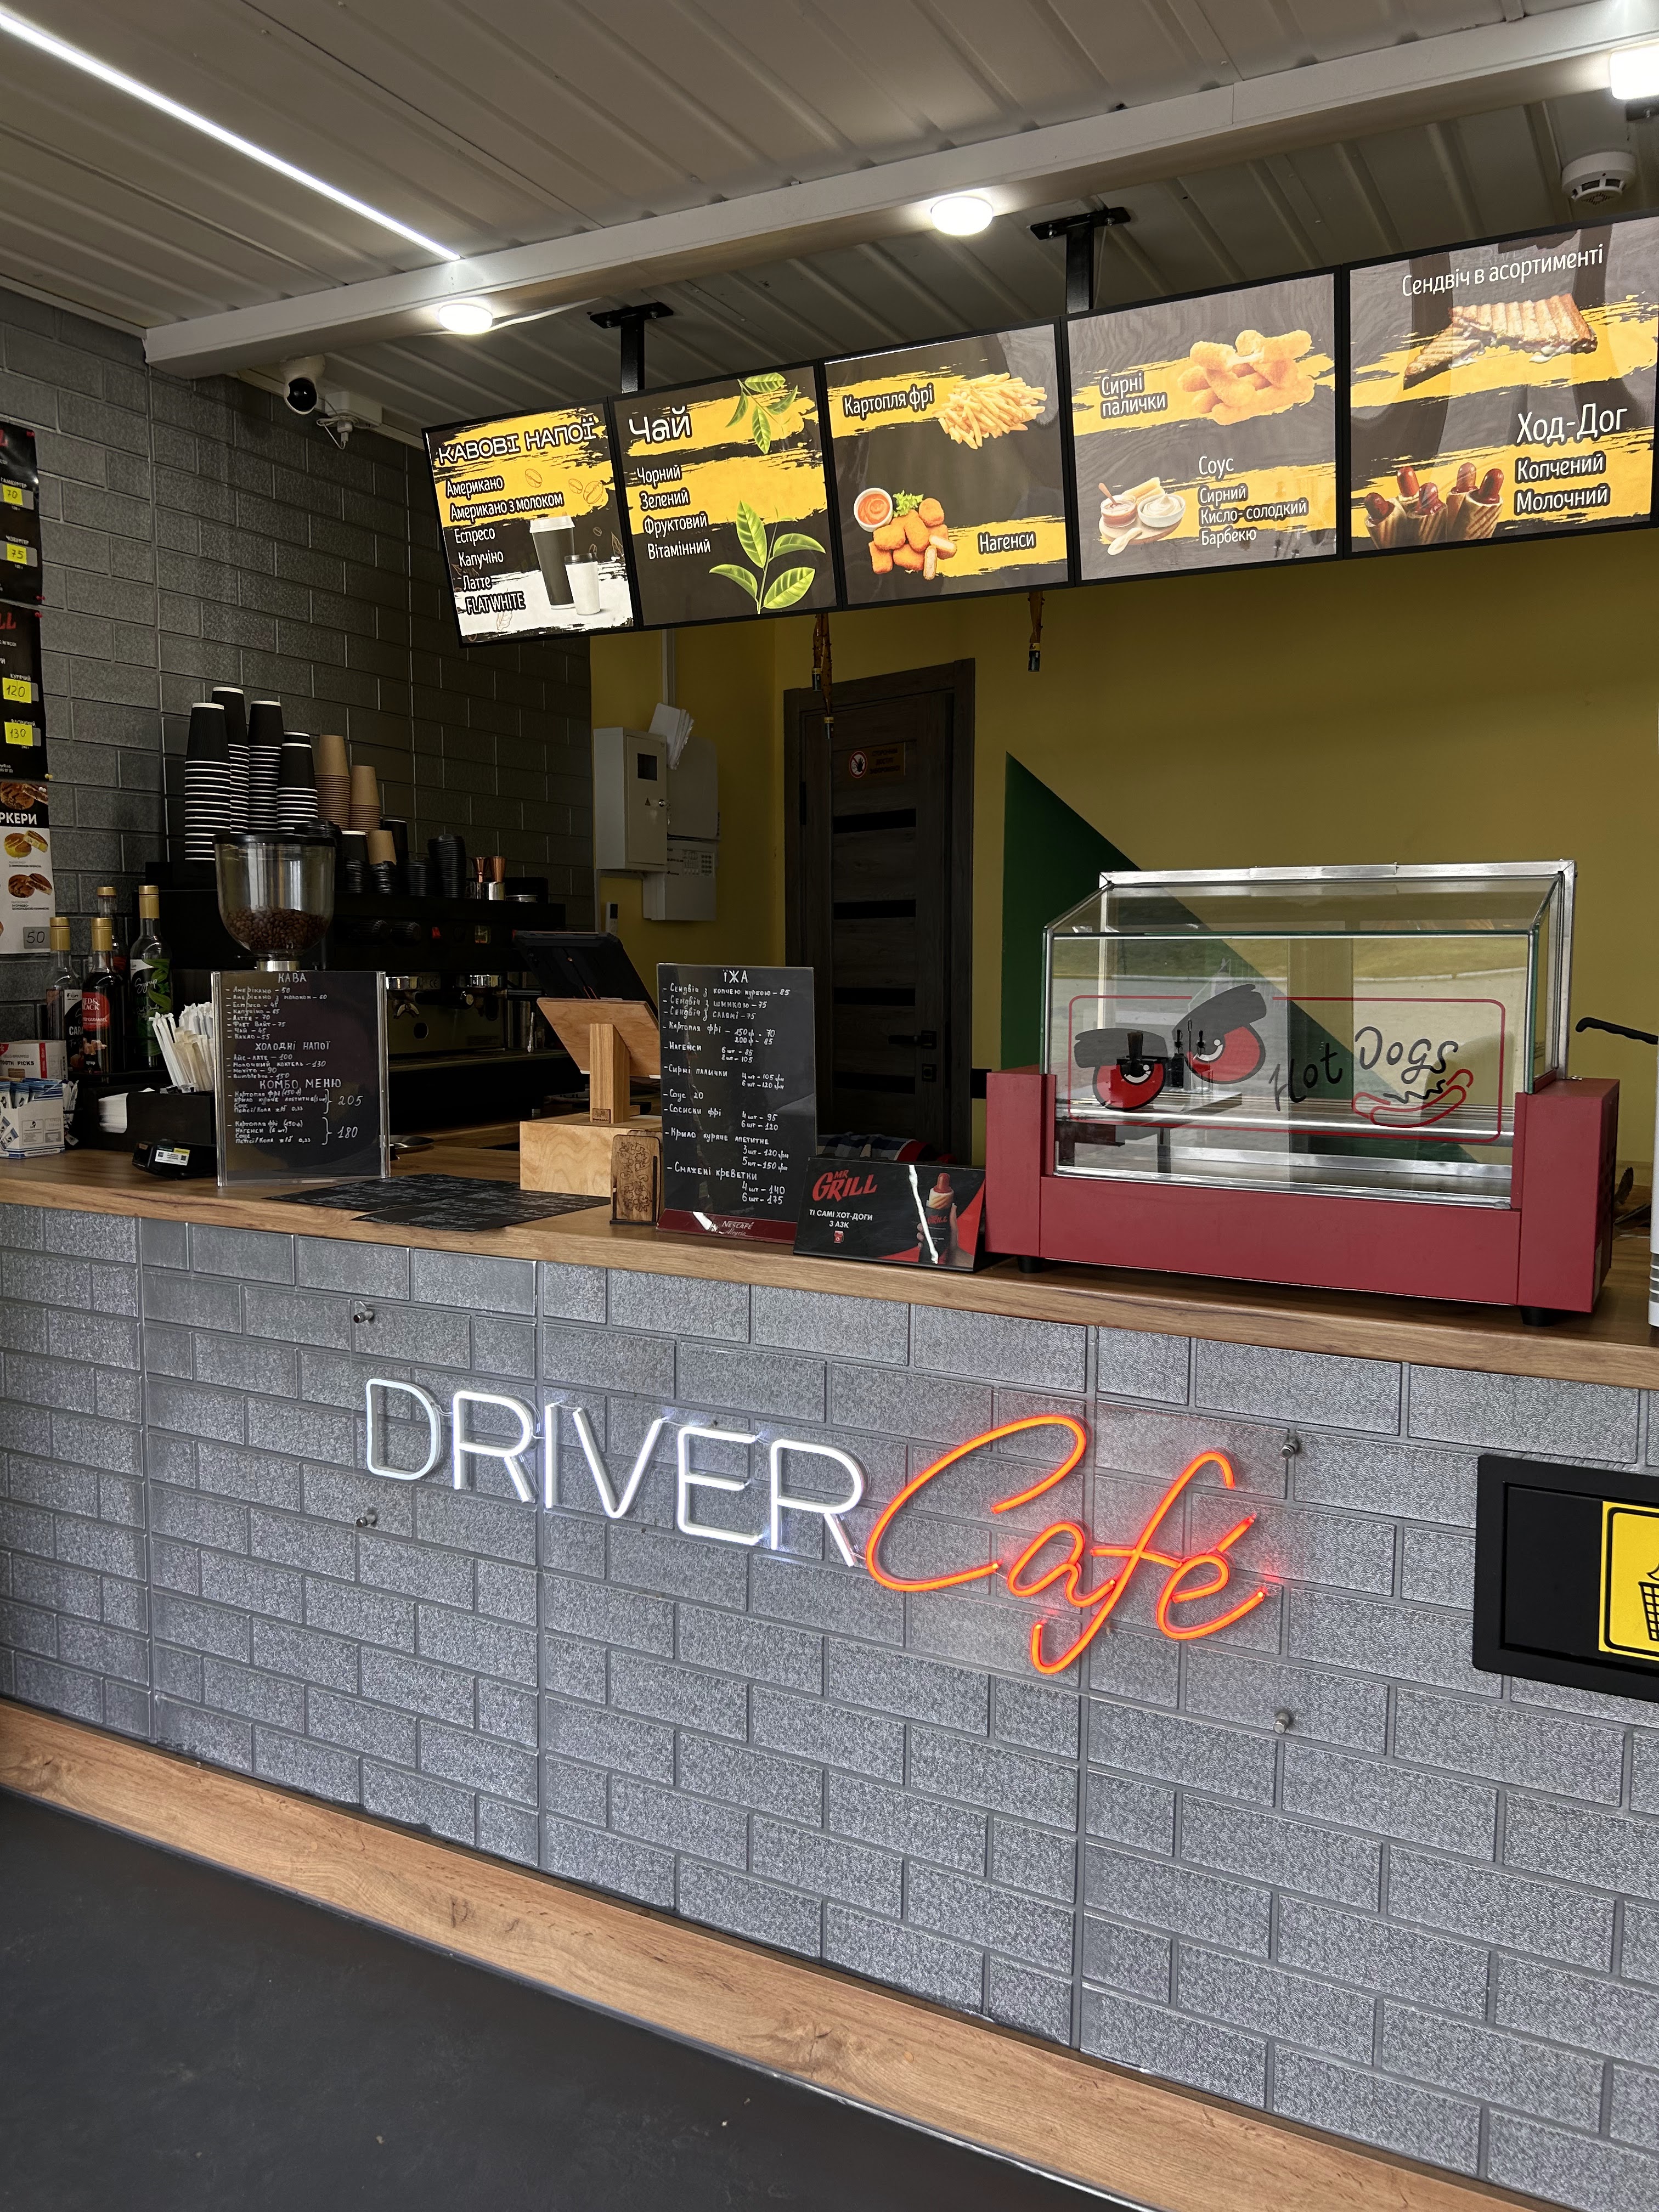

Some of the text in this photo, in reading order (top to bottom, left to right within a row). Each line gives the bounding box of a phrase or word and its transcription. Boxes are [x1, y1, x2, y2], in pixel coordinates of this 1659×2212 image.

[1402, 269, 1470, 297] Сендвіч
[1474, 268, 1485, 285] в
[1489, 244, 1604, 284] асортименті
[1100, 372, 1143, 399] Сирні
[844, 385, 934, 419] Картопля фрі
[1102, 393, 1166, 417] палички
[628, 406, 691, 443] Чай
[1516, 403, 1628, 444] Ход-Дог
[439, 417, 596, 465] КАВОВІ НАПОЇ
[636, 464, 681, 487] Чорний
[1198, 455, 1234, 479] Соус
[1517, 454, 1604, 482] Копчений
[6, 489, 19, 499] 70
[446, 476, 503, 499] Американо
[1199, 485, 1246, 507] Сирний
[450, 494, 563, 522] Американо з молоком
[640, 490, 689, 510] Зелений
[1516, 486, 1608, 514] Молочний
[1245, 500, 1307, 522] солодкий
[644, 512, 708, 538] Фруктовий
[454, 527, 495, 548] Еспресо
[979, 532, 1035, 553] Нагенси
[1201, 528, 1257, 548] Барбекю
[12, 549, 24, 560] 75
[647, 538, 712, 560] Вітамінний
[458, 550, 504, 570] Капучіно
[462, 575, 492, 591] Латте
[6, 685, 26, 697] 120
[10, 728, 27, 739] 130
[26, 931, 45, 944] 50
[278, 972, 307, 984] КАВА
[722, 969, 749, 984] ЇЖА
[669, 982, 699, 996] Сендвіч
[744, 990, 771, 1000] куркою
[669, 994, 701, 1009] Сендвіч
[713, 1000, 750, 1009] шинкою
[669, 1006, 701, 1020] Сендвіч
[713, 1011, 740, 1020] салямі
[669, 1020, 776, 1037] Картопля фрі 70
[255, 1040, 331, 1051] ХОЛОДНІ НАПОЇ
[744, 1048, 754, 1057] 85
[669, 1063, 728, 1077] Сирні палички
[1267, 1025, 1460, 1113] Hot Dogs
[259, 1078, 342, 1089] КОМБО МЕНЮ
[338, 1095, 364, 1107] 205
[669, 1088, 704, 1103] Соус 20
[669, 1103, 722, 1119] Сосиски фрі
[766, 1113, 778, 1121] 95
[337, 1126, 358, 1139] 180
[765, 1122, 779, 1131] 120
[670, 1127, 769, 1146] Крило куряче апетитне
[763, 1149, 778, 1157] 120
[674, 1161, 758, 1181] Смажені креветки
[762, 1161, 777, 1170] 150
[833, 1169, 850, 1180] MR
[769, 1185, 786, 1195] 140
[812, 1171, 878, 1202] GRILL
[766, 1194, 784, 1205] 175
[816, 1209, 835, 1218] САМІ
[836, 1211, 874, 1221] ХОТ-ДОГИ
[721, 1221, 755, 1230] NESCAFÉ
[364, 1376, 1271, 1675] DRIVER Café
